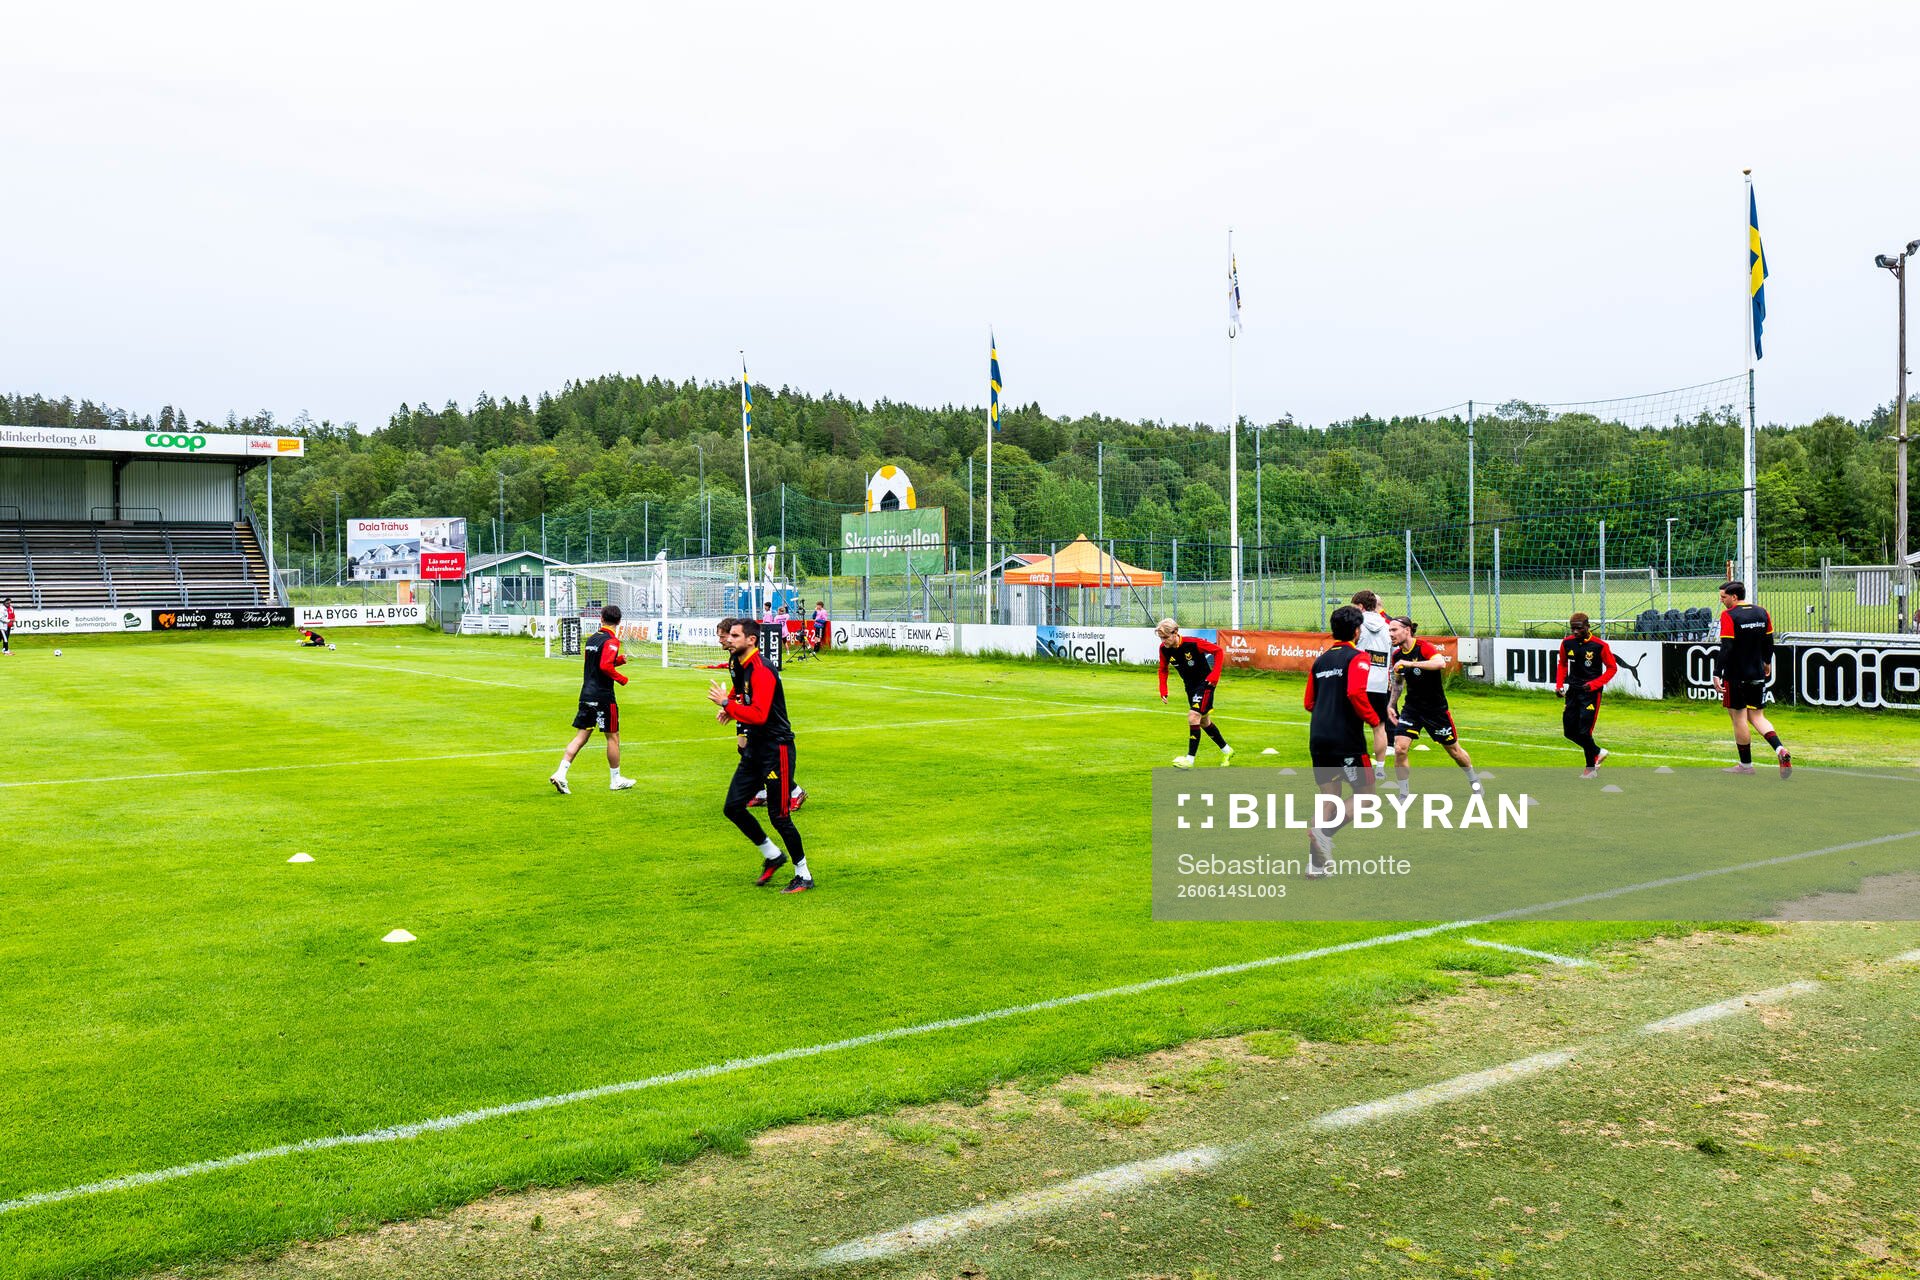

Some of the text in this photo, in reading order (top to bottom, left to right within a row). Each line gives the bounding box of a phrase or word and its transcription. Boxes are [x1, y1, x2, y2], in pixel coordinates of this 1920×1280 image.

[80, 434, 97, 445] AB
[145, 433, 207, 452] coop
[359, 522, 409, 531] Dala Trähus
[845, 528, 940, 558] Skarsjövallen
[1029, 573, 1050, 583] renta
[177, 613, 206, 622] alwico
[303, 607, 418, 620] H.A BYGG H.A BYGG
[12, 616, 70, 630] ungskile
[851, 623, 897, 639] LJUNGSKILE
[900, 624, 932, 640] TEKNIK
[1055, 630, 1071, 640] säljer
[1231, 635, 1248, 648] ICA
[1047, 639, 1125, 664] Solceller
[1267, 644, 1281, 656] För
[1281, 644, 1304, 657] både
